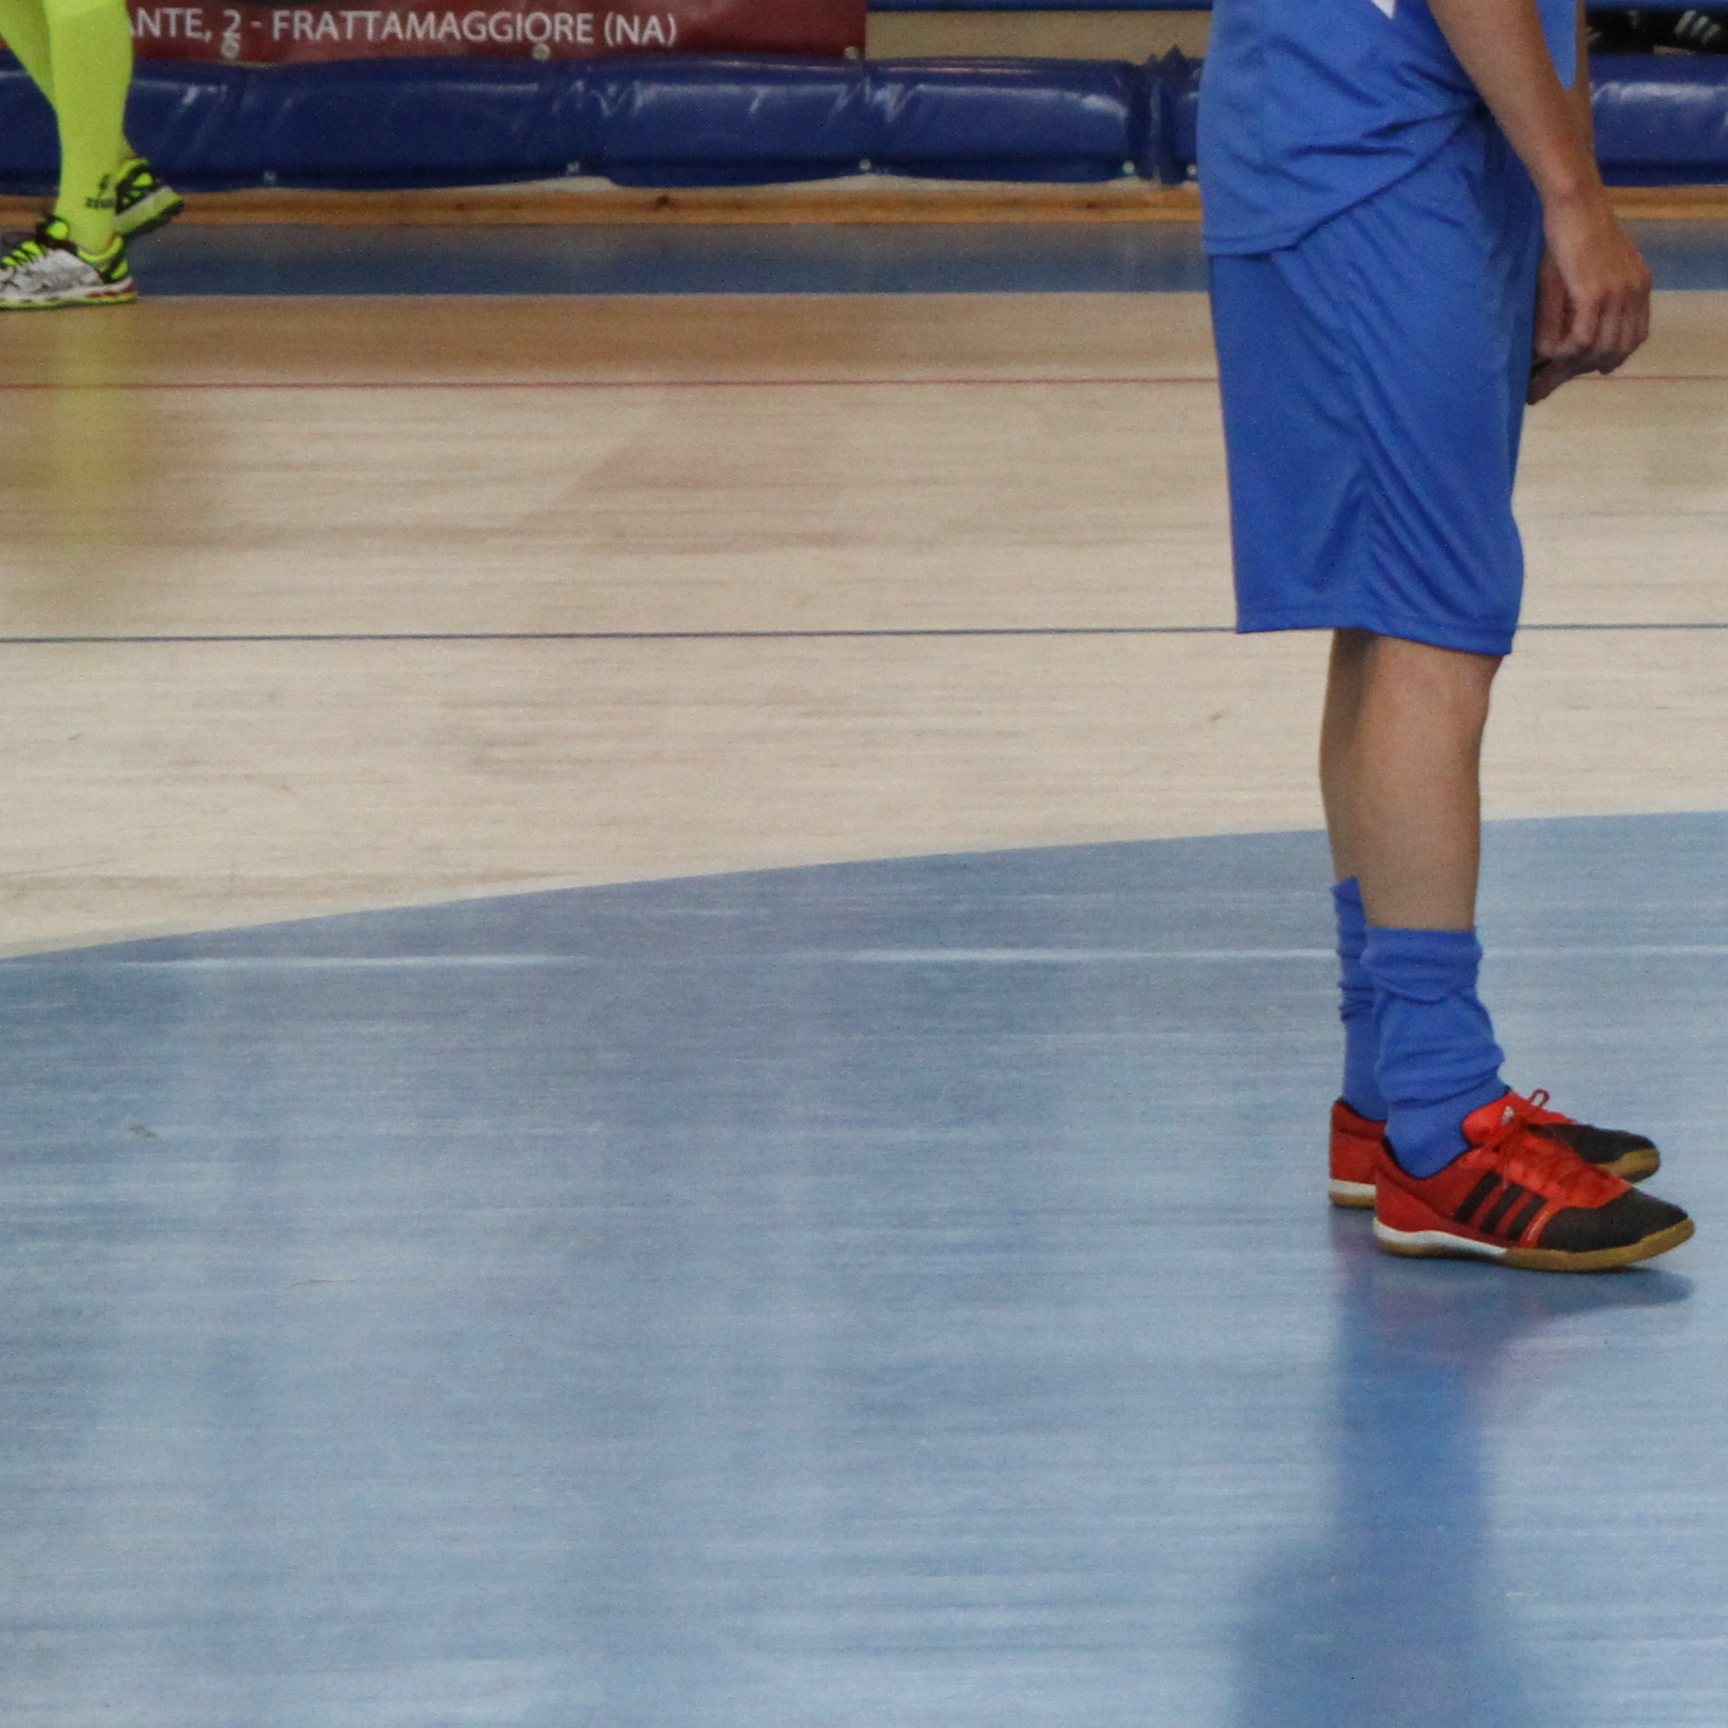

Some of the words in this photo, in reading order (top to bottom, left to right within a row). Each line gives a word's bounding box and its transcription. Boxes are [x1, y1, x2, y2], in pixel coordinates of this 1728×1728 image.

[223, 8, 241, 39] 2
[272, 10, 594, 44] FRATTAMAGGIORE
[604, 12, 677, 47] (NA)
